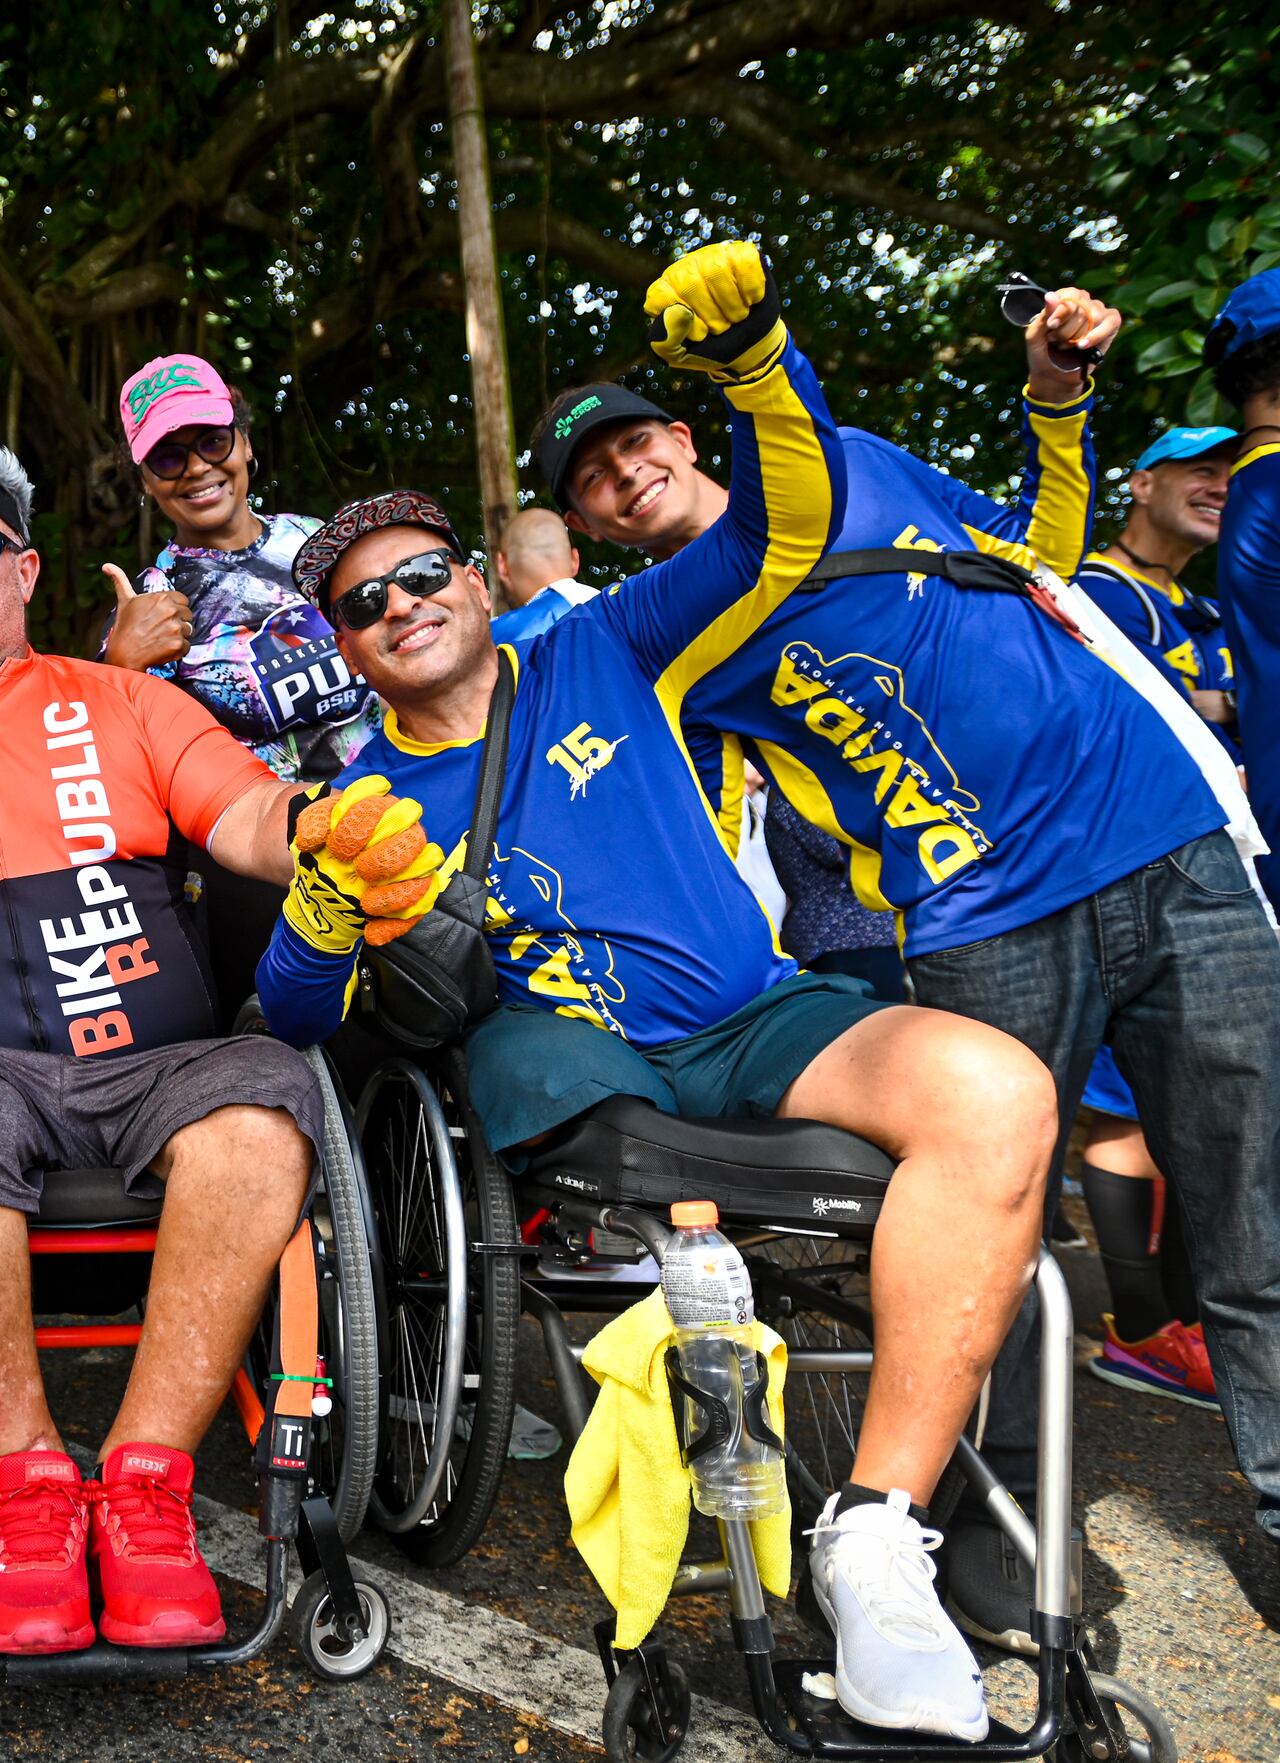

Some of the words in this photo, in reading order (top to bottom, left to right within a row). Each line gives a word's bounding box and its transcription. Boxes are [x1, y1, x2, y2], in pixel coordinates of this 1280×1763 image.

[316, 688, 357, 716] BSR
[546, 721, 614, 782] 15
[43, 701, 160, 986] REPUBLIC
[39, 918, 134, 1057] BIKE
[829, 1198, 861, 1212] Mobility
[281, 1424, 303, 1457] Ti
[30, 1464, 69, 1476] RBX
[127, 1456, 166, 1473] RBX
